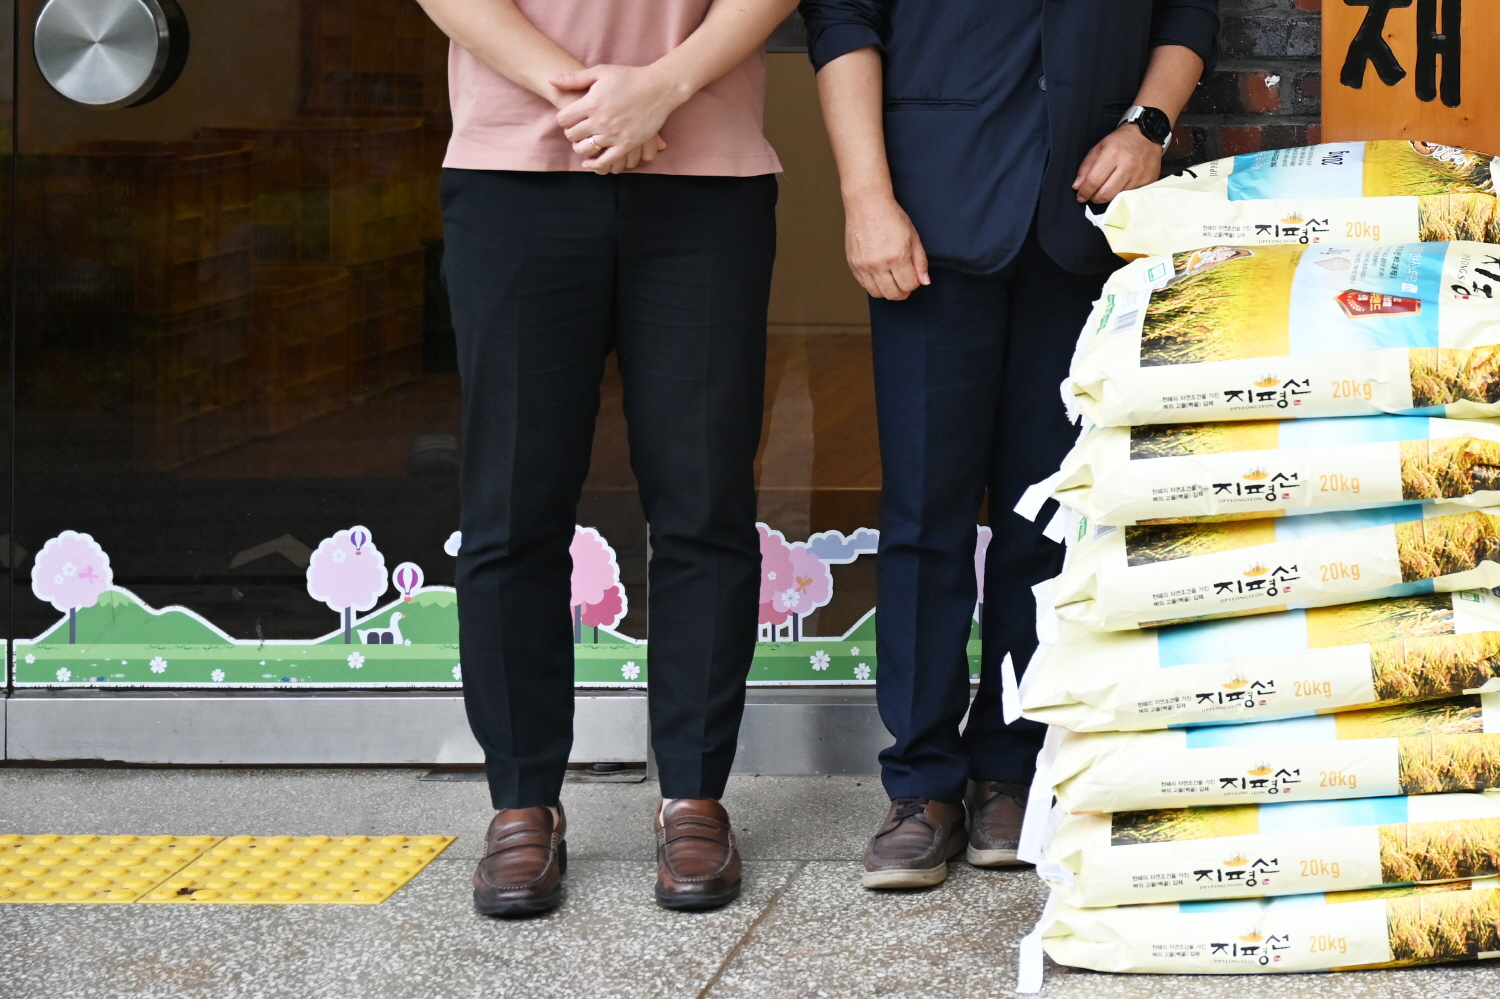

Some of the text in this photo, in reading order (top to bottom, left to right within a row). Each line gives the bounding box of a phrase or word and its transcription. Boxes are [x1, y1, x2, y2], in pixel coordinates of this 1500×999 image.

[1255, 218, 1329, 244] 지평선
[1346, 222, 1380, 241] 20kg
[1224, 379, 1311, 408] 지평선
[1332, 380, 1372, 400] 20kg
[1213, 472, 1300, 501] 지평선
[1320, 475, 1360, 493] 20kg
[1213, 565, 1300, 596] 지평선
[1320, 562, 1360, 582] 20kg
[1196, 680, 1276, 708] 지평선
[1294, 680, 1332, 697] 20kg
[1220, 768, 1301, 794] 지평선
[1319, 771, 1357, 789] 20kg
[1193, 858, 1280, 886] 지평선
[1300, 860, 1340, 878] 20kg
[1211, 934, 1290, 965] 지평선
[1309, 935, 1346, 954] 20kg
